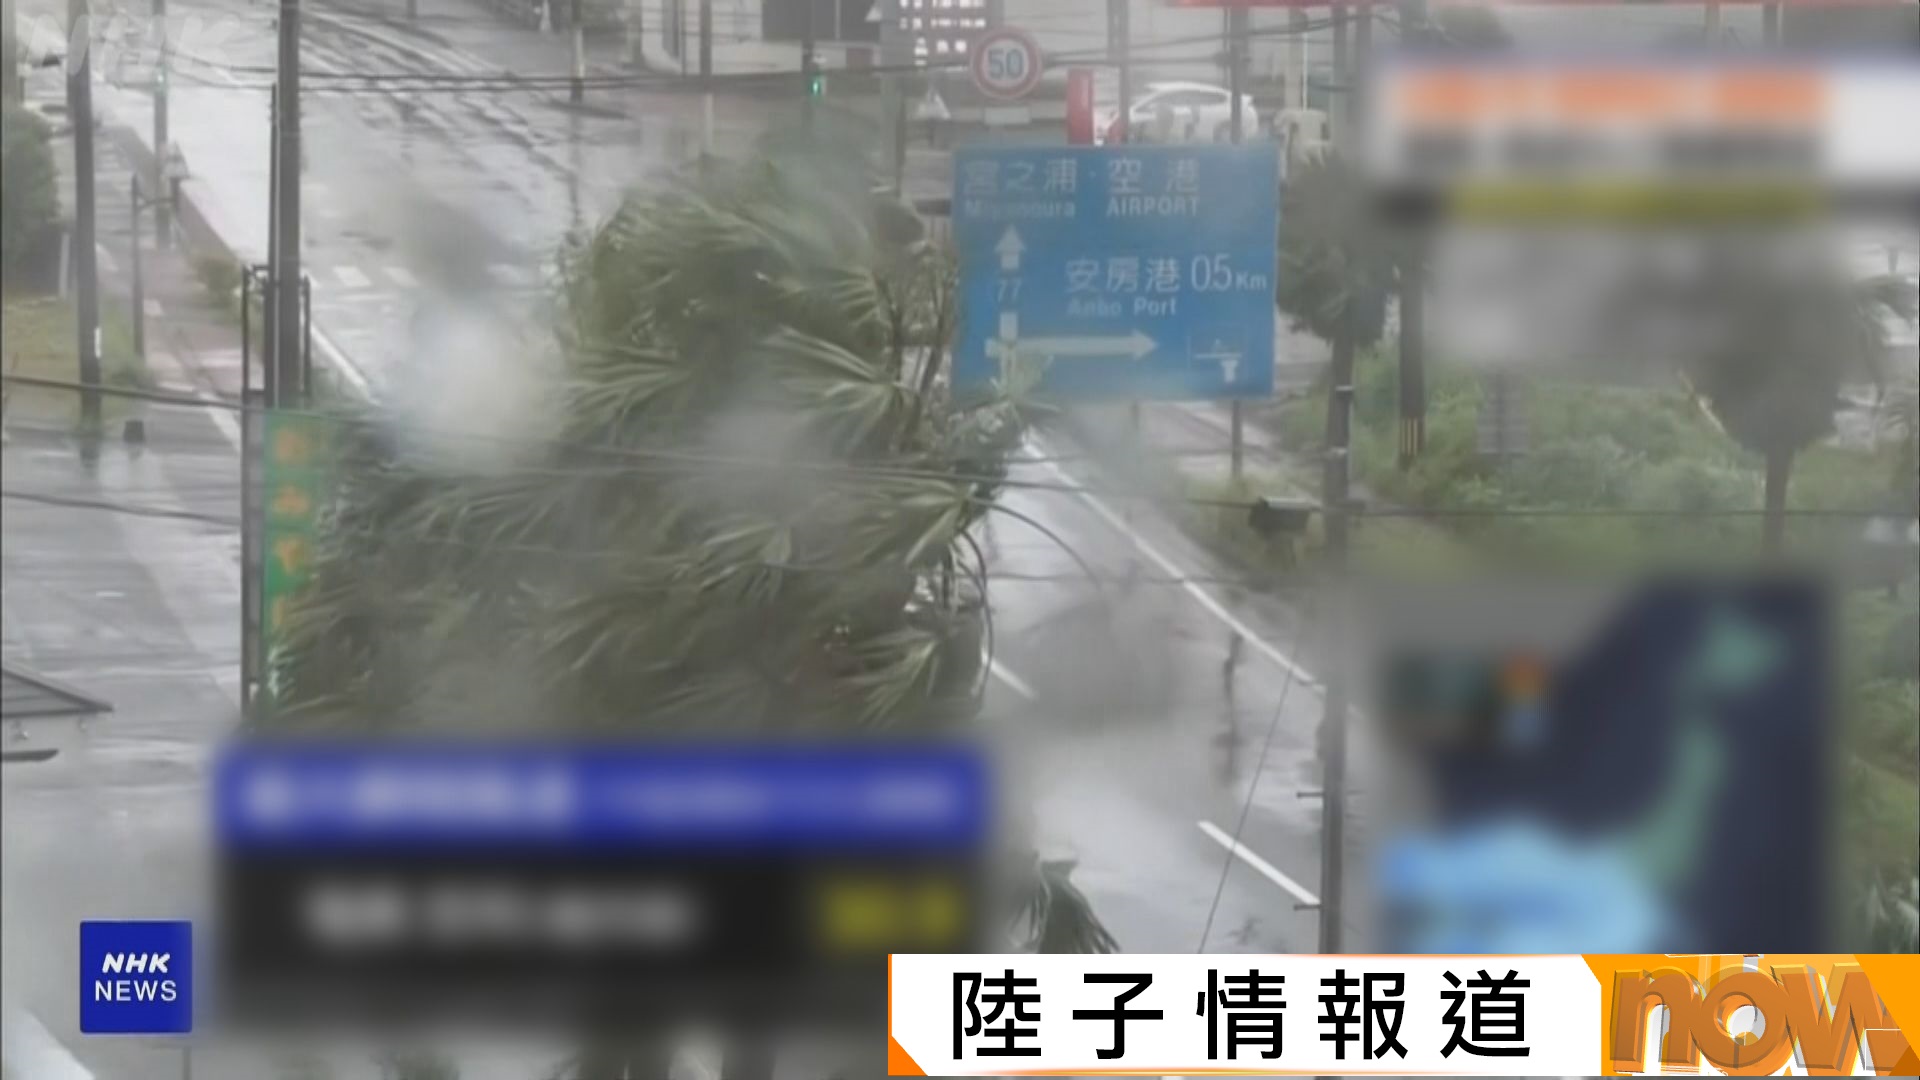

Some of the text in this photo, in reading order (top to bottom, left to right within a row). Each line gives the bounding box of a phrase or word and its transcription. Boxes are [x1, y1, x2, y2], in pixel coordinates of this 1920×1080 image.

[987, 47, 1024, 80] 50
[1105, 196, 1201, 218] AIRPORT
[1064, 256, 1181, 293] 安房港
[995, 277, 1023, 303] 77
[1133, 296, 1177, 317] Port
